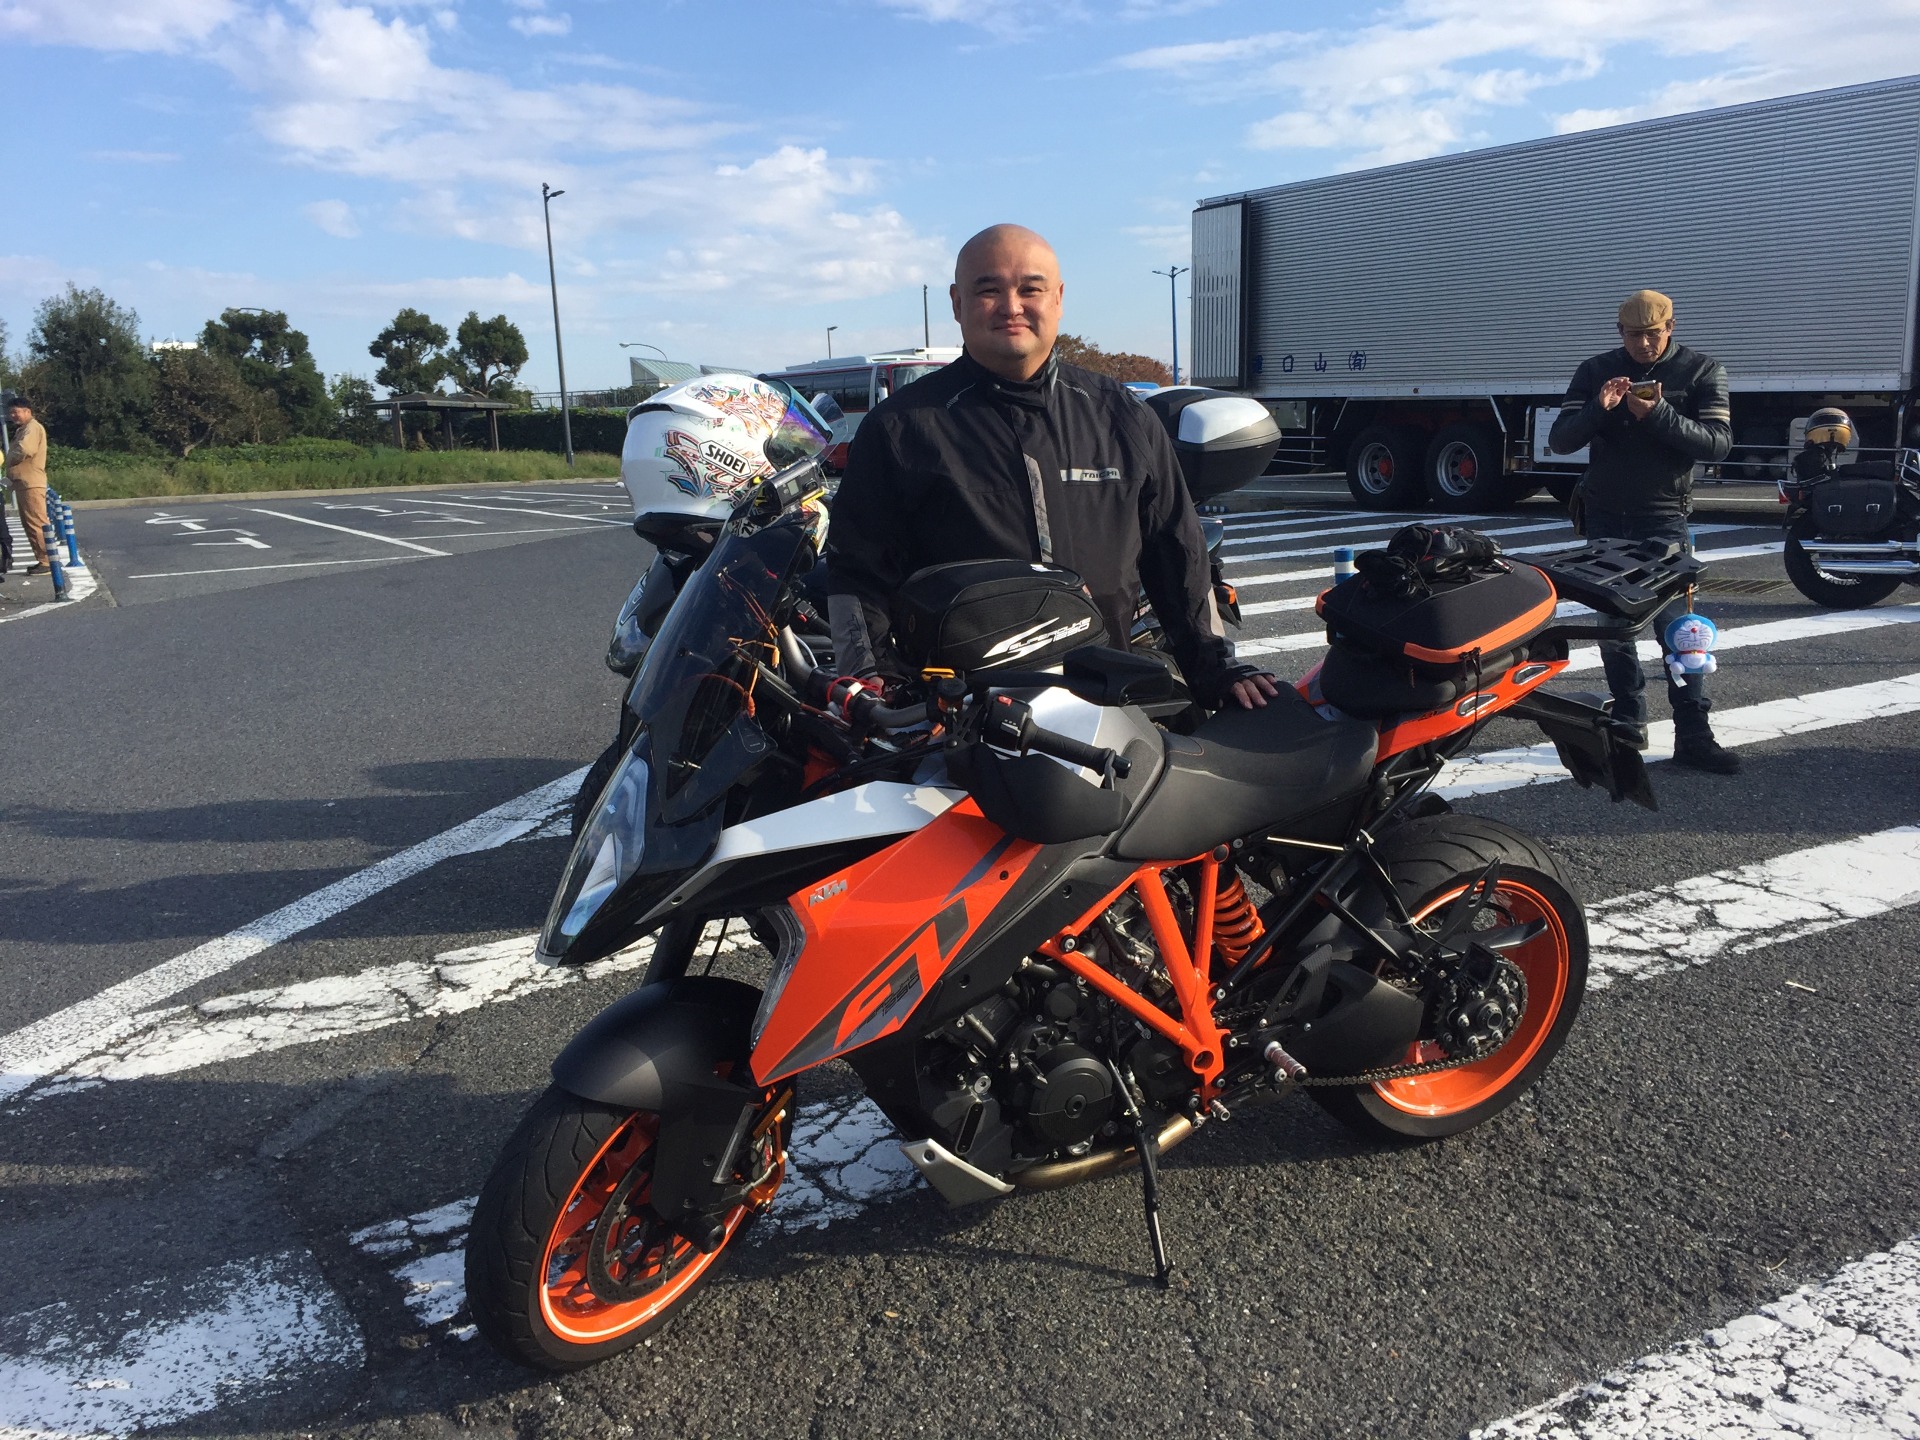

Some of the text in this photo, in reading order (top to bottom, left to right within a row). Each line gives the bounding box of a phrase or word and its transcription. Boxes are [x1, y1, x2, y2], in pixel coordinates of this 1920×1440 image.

[705, 444, 747, 474] SHOEI
[1082, 470, 1117, 479] TAICHI
[808, 879, 847, 907] KTM
